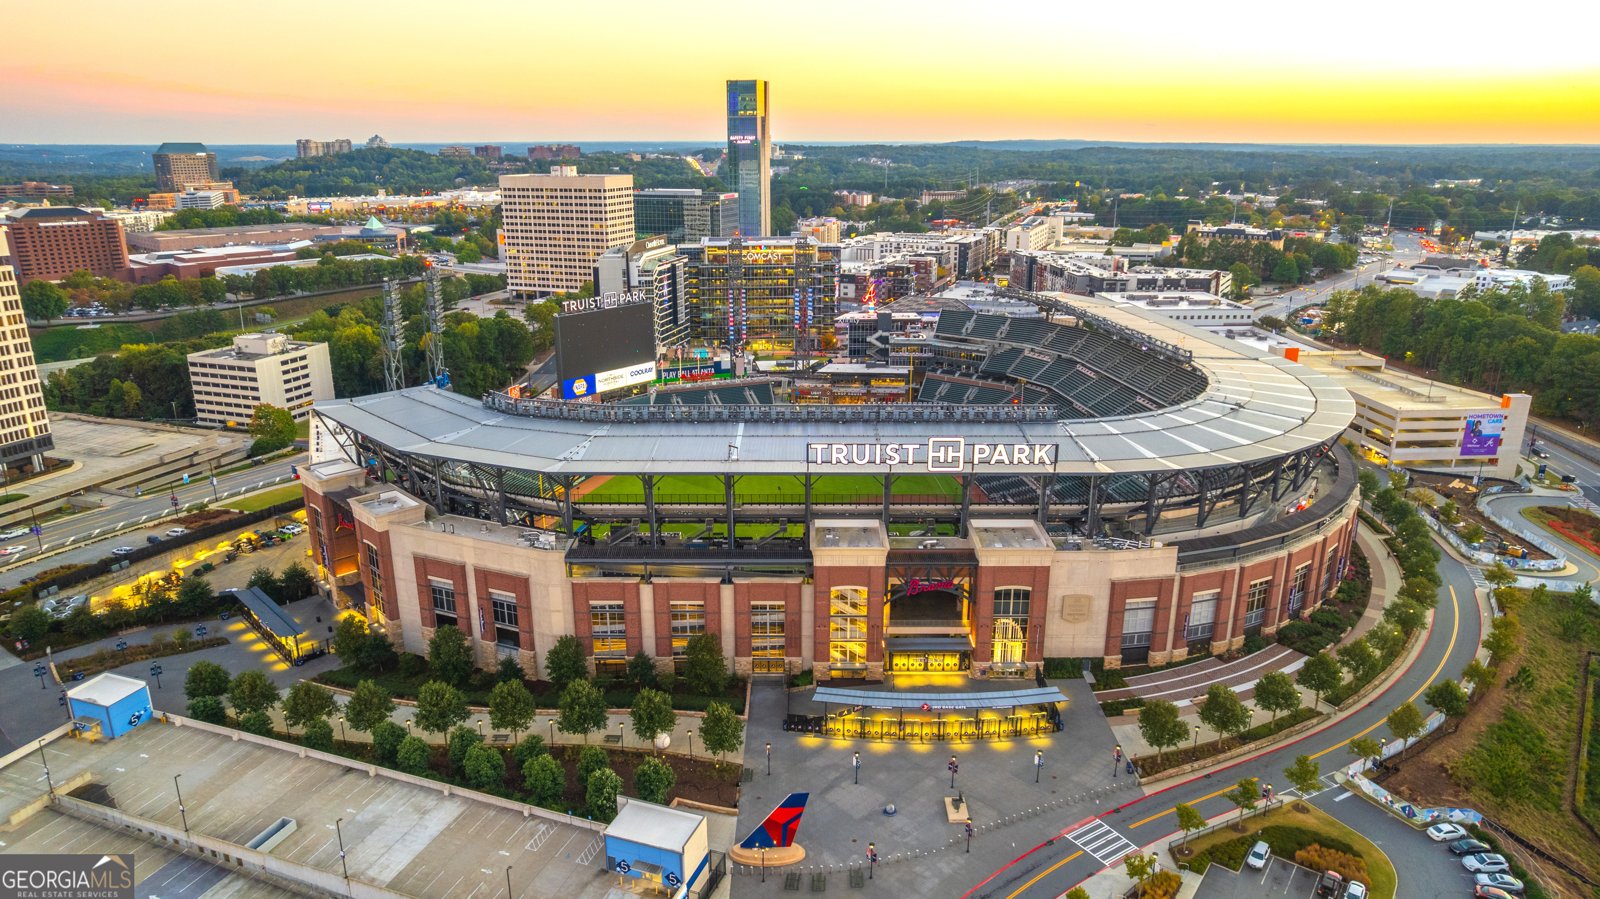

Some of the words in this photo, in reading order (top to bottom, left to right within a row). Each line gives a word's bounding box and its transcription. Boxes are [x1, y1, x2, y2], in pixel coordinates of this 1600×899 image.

[741, 252, 783, 260] COMCAST
[562, 296, 602, 312] TRUIST
[619, 290, 646, 303] PARK
[629, 367, 653, 377] COOLRAY
[663, 370, 677, 379] PLAY
[810, 444, 920, 465] TRUIST
[973, 444, 1053, 465] PARK
[131, 716, 139, 726] 5
[620, 861, 629, 872] 5
[669, 874, 677, 885] 5
